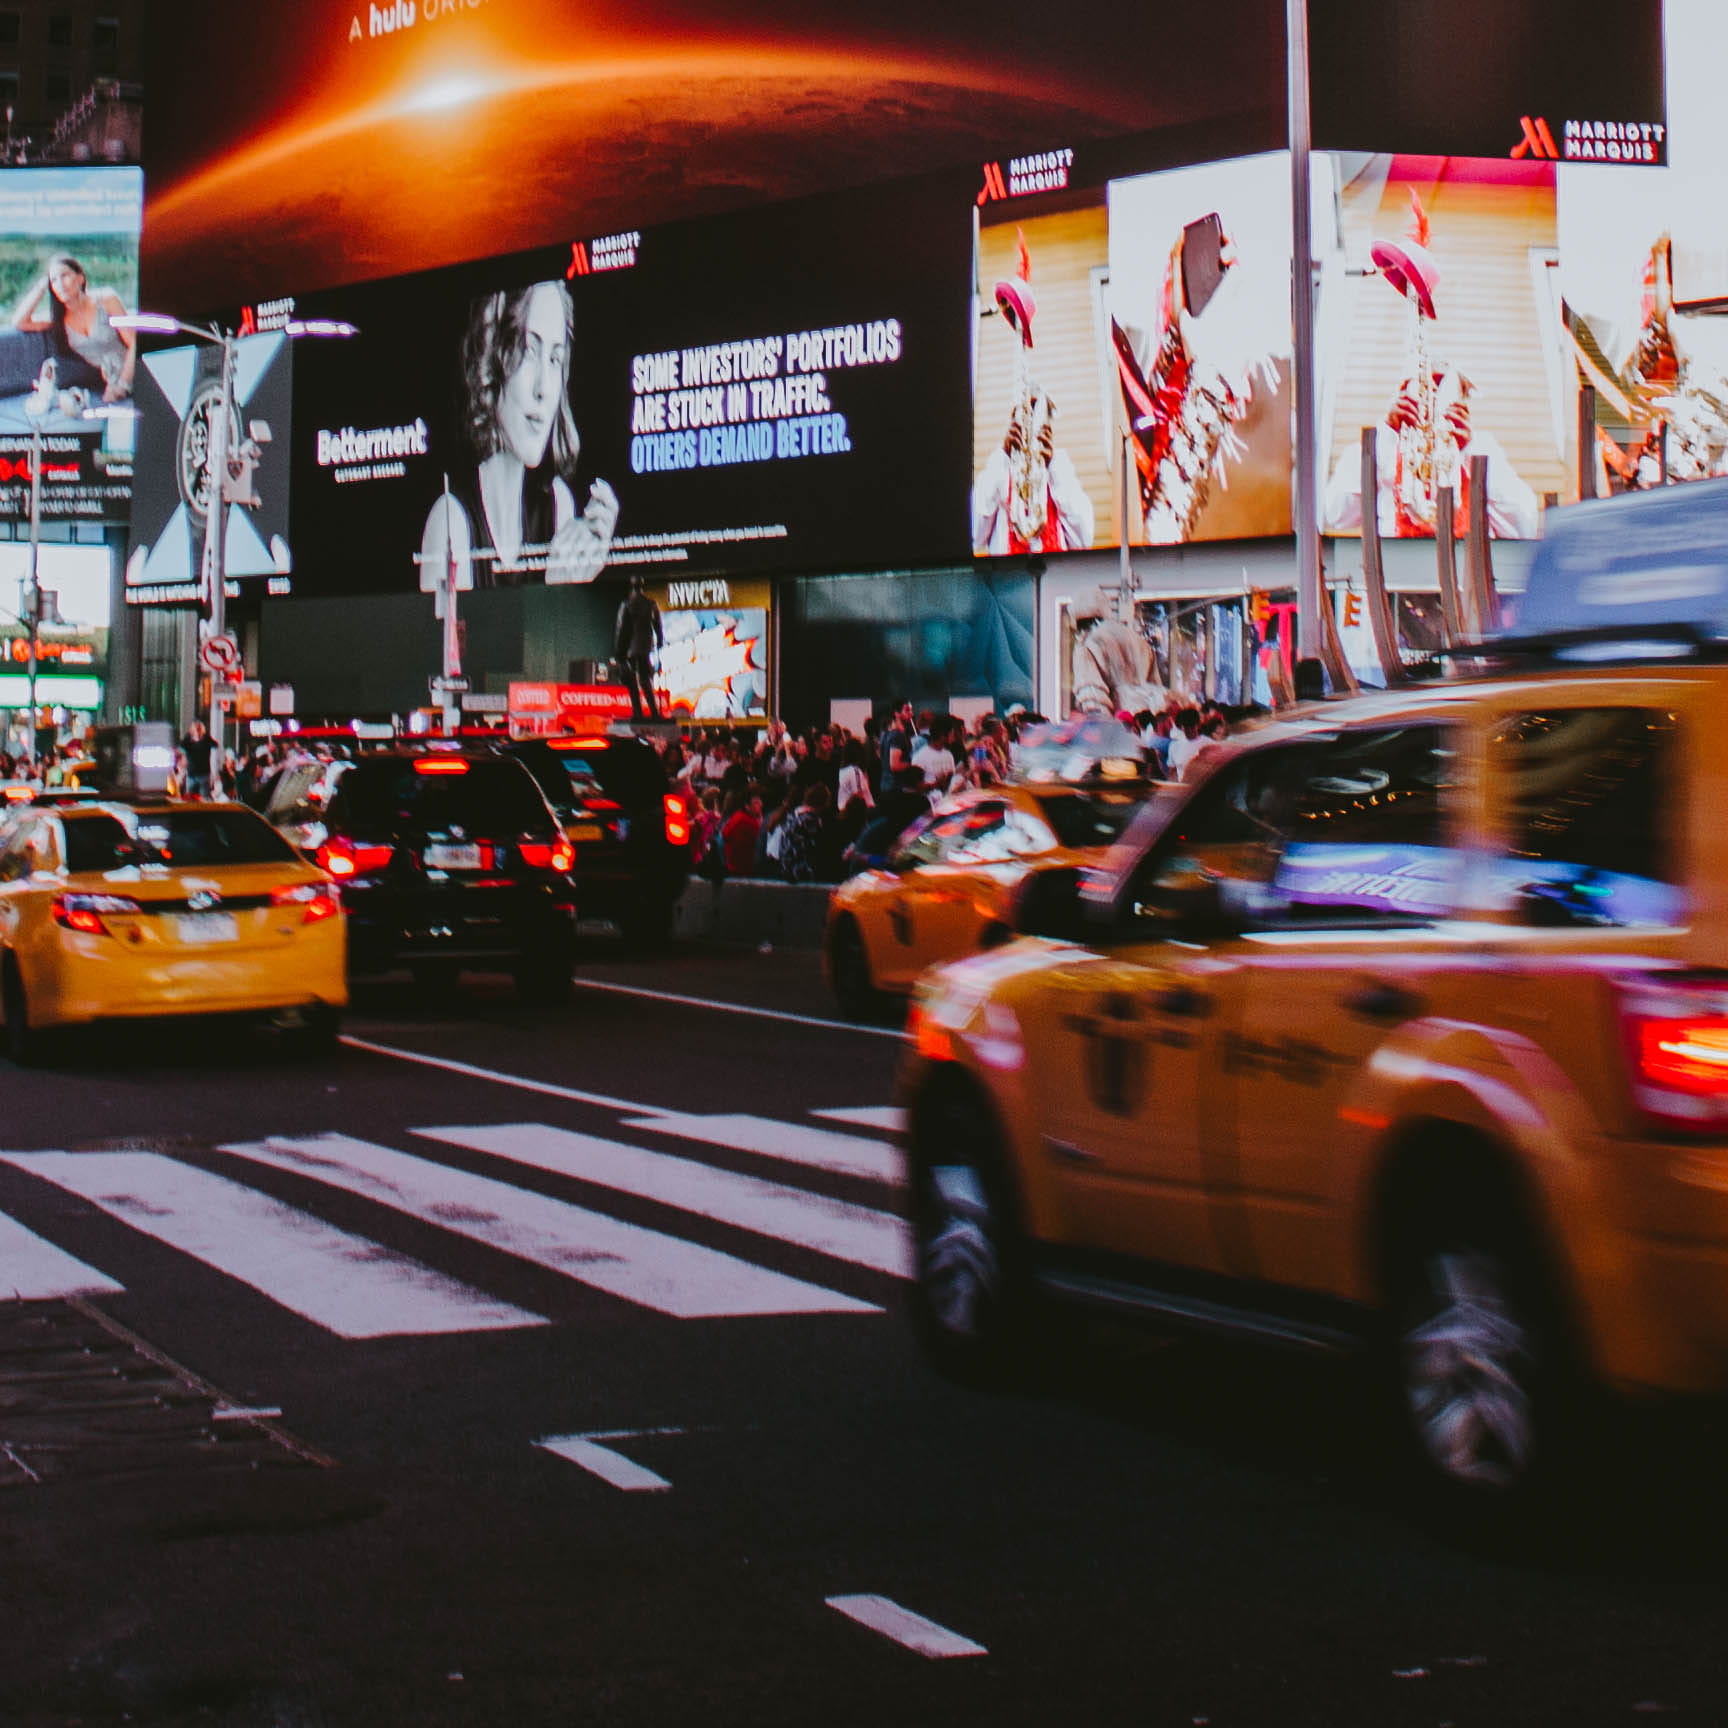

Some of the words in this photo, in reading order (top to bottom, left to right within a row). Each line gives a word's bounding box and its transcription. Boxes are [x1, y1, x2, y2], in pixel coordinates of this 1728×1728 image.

[348, 17, 363, 44] A
[1565, 118, 1666, 143] MARRIOTT
[1011, 148, 1073, 177] MARRIOTT
[1565, 139, 1656, 160] MARQUIS
[1011, 168, 1068, 196] MARQUIS
[592, 231, 641, 253] MARRIOTT
[592, 248, 636, 270] MARQUIS
[257, 297, 295, 316] MARRIOTT
[257, 312, 292, 332] MARQUIS
[633, 350, 680, 394] SOME
[681, 336, 784, 388] INVESTORS'
[786, 318, 901, 373] PORTFOLIOS
[632, 393, 667, 434] ARE
[668, 386, 724, 430] STUCK
[726, 382, 747, 422] IN
[748, 372, 831, 420] TRAFFIC.
[318, 417, 427, 465] Betterment
[632, 430, 698, 474] OTHERS
[698, 422, 773, 467] DEMAND
[776, 412, 852, 459] BETTER.
[668, 578, 730, 607] INVICTA
